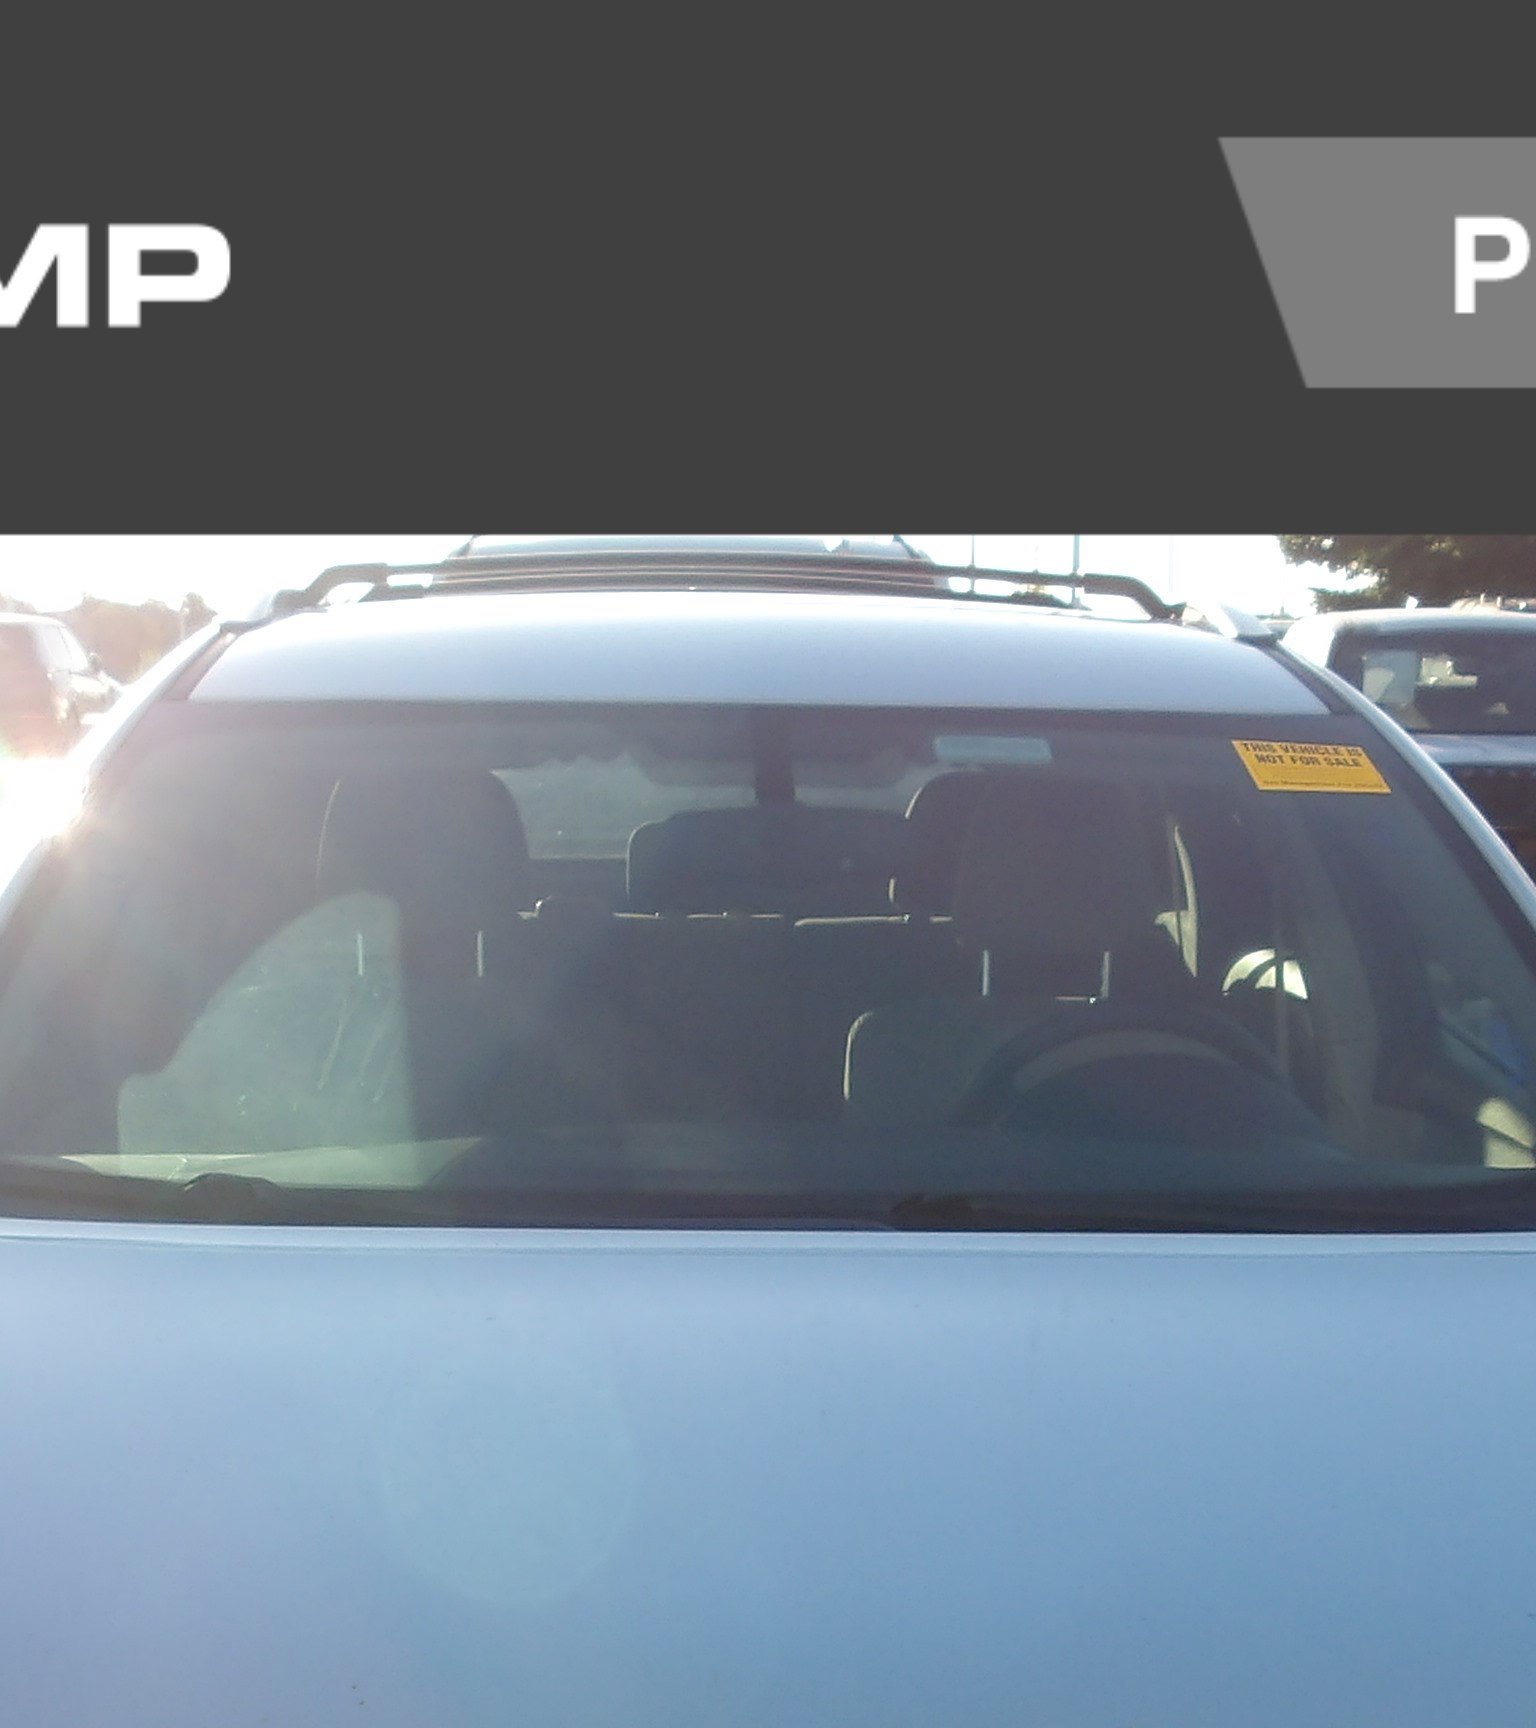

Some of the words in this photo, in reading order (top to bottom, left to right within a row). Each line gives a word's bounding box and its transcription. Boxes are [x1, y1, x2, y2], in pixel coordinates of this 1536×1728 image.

[1242, 743, 1275, 753] THIS
[1279, 744, 1344, 756] VEHICLE
[1346, 747, 1363, 757] IS
[1255, 754, 1285, 764] NOT
[1290, 755, 1321, 765] FOR
[1324, 757, 1363, 767] SALE
